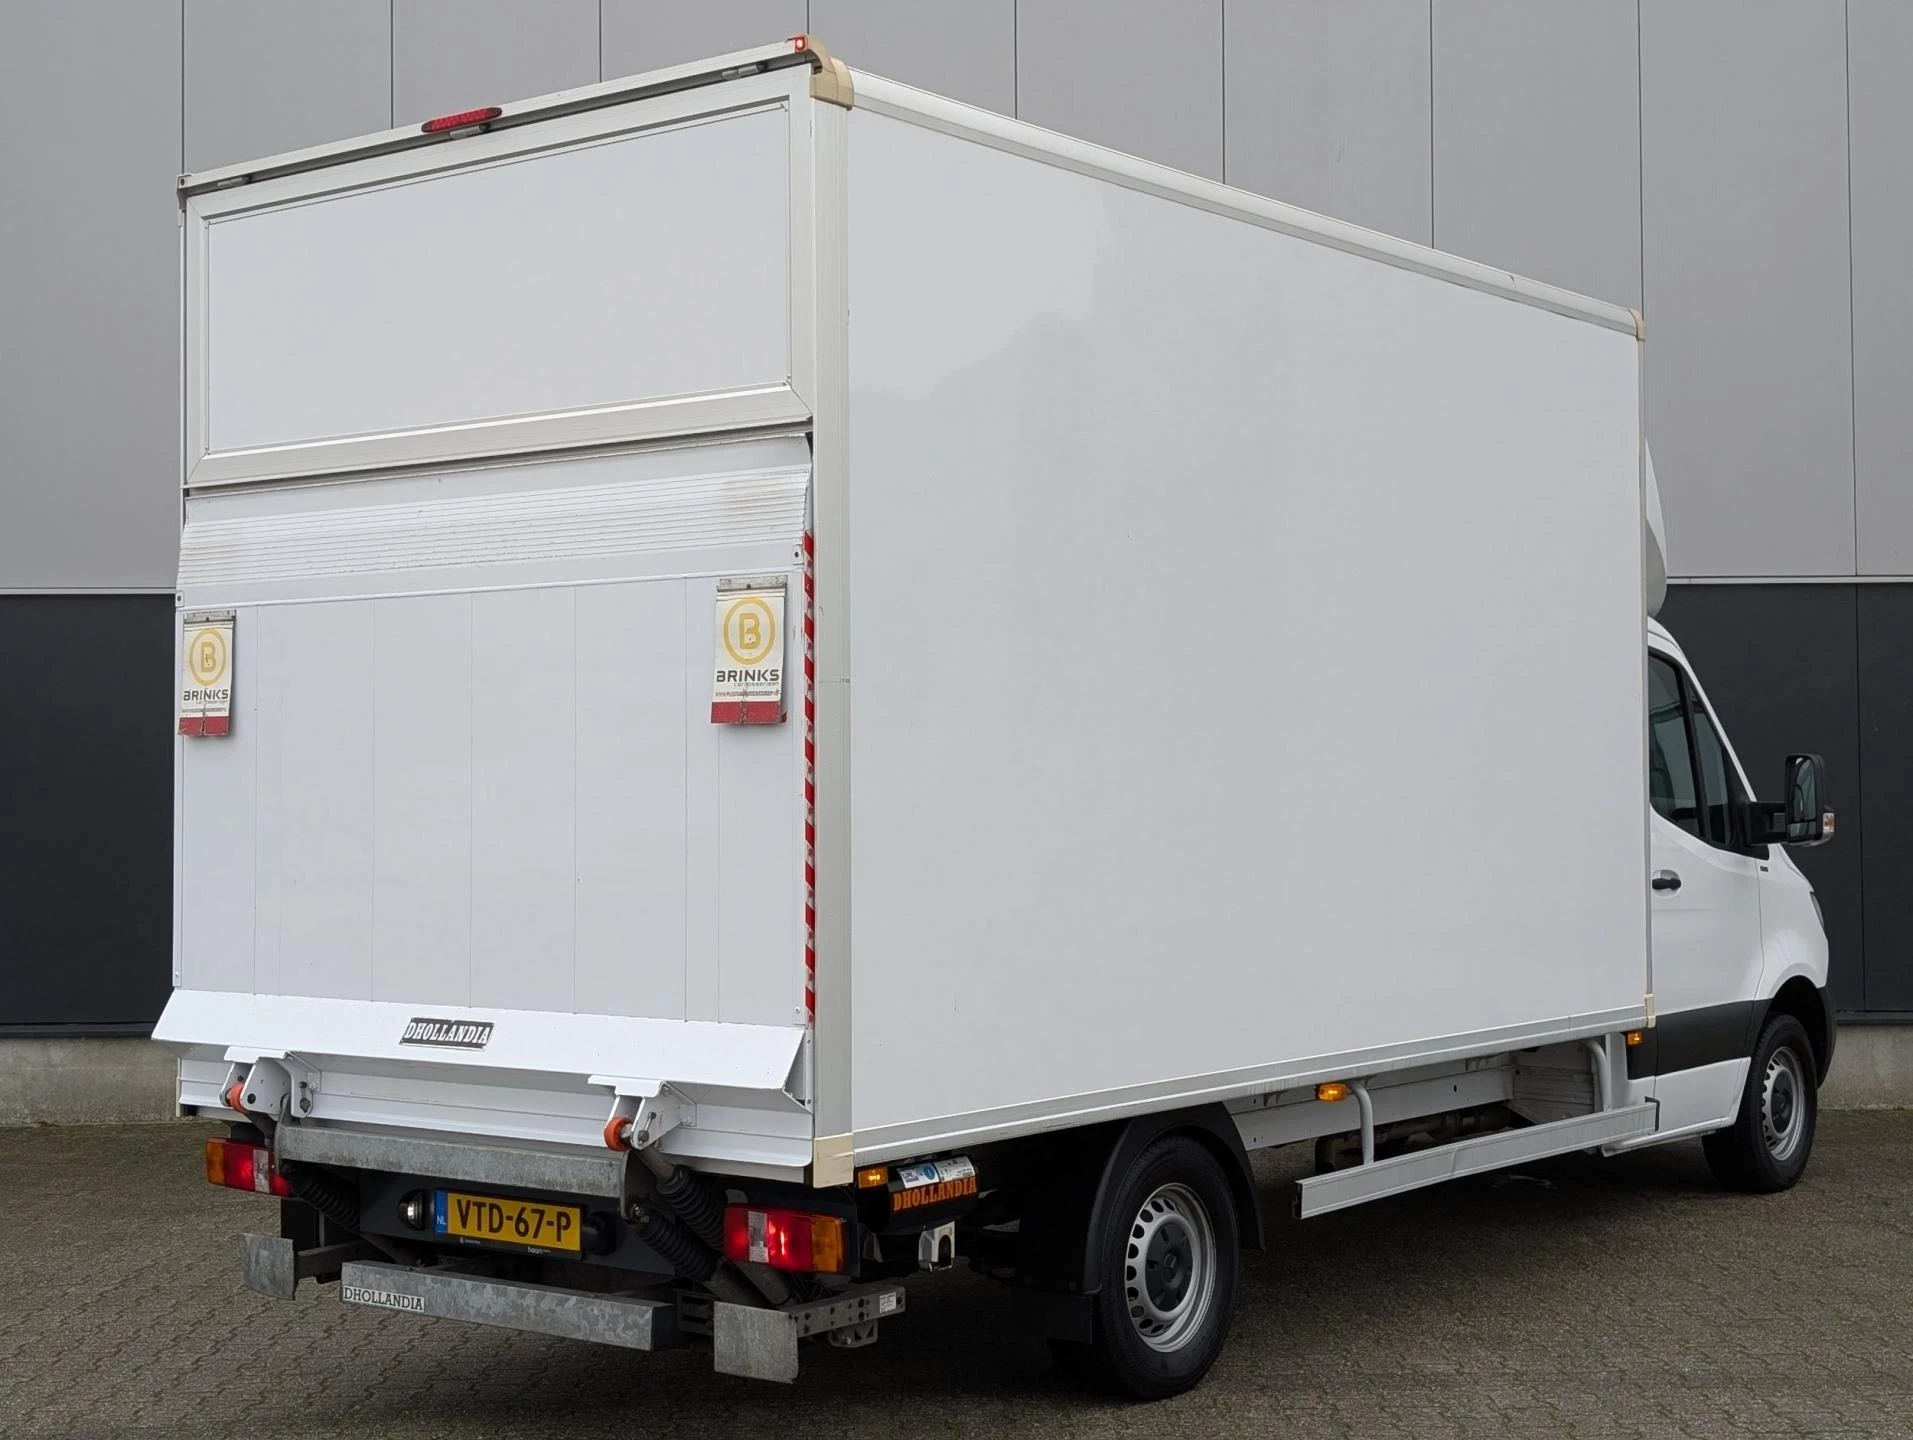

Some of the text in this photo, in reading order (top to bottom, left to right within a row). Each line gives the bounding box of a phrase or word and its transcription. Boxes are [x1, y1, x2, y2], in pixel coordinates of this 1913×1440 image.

[739, 612, 761, 650] B
[201, 641, 216, 673] B
[716, 669, 780, 682] BRINKS
[183, 689, 229, 701] BRINKS
[403, 1021, 490, 1044] DHOLLANDIA
[893, 1176, 977, 1211] DHOLLANDIA
[436, 1215, 447, 1225] NL
[456, 1198, 572, 1242] VTD-67-P
[344, 1287, 423, 1311] DHOLLANDIA
